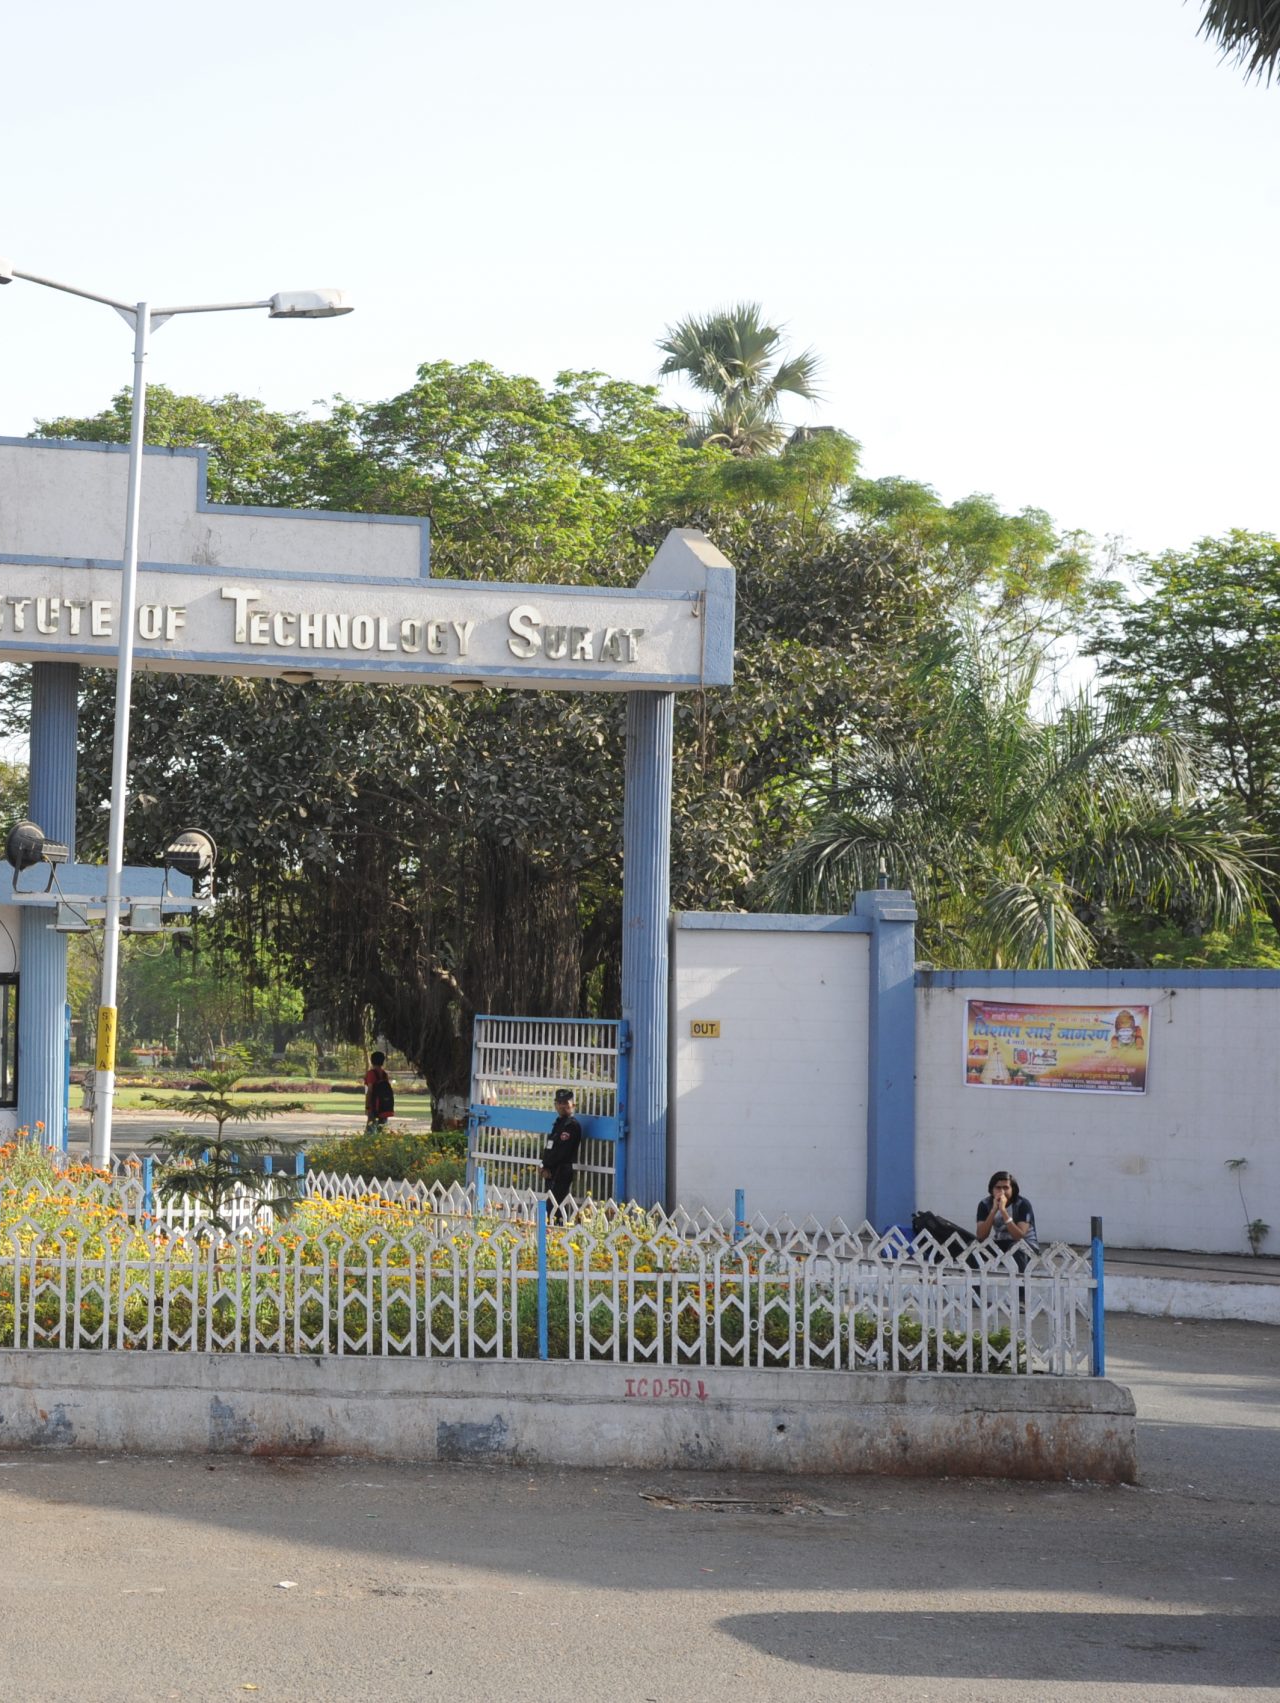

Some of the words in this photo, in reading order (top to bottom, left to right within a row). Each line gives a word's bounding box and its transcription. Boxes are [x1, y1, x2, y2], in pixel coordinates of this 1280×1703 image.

[138, 604, 187, 640] OF
[222, 586, 475, 656] TECHNOLOGY
[507, 604, 644, 662] SURAT
[694, 1023, 716, 1034] OUT
